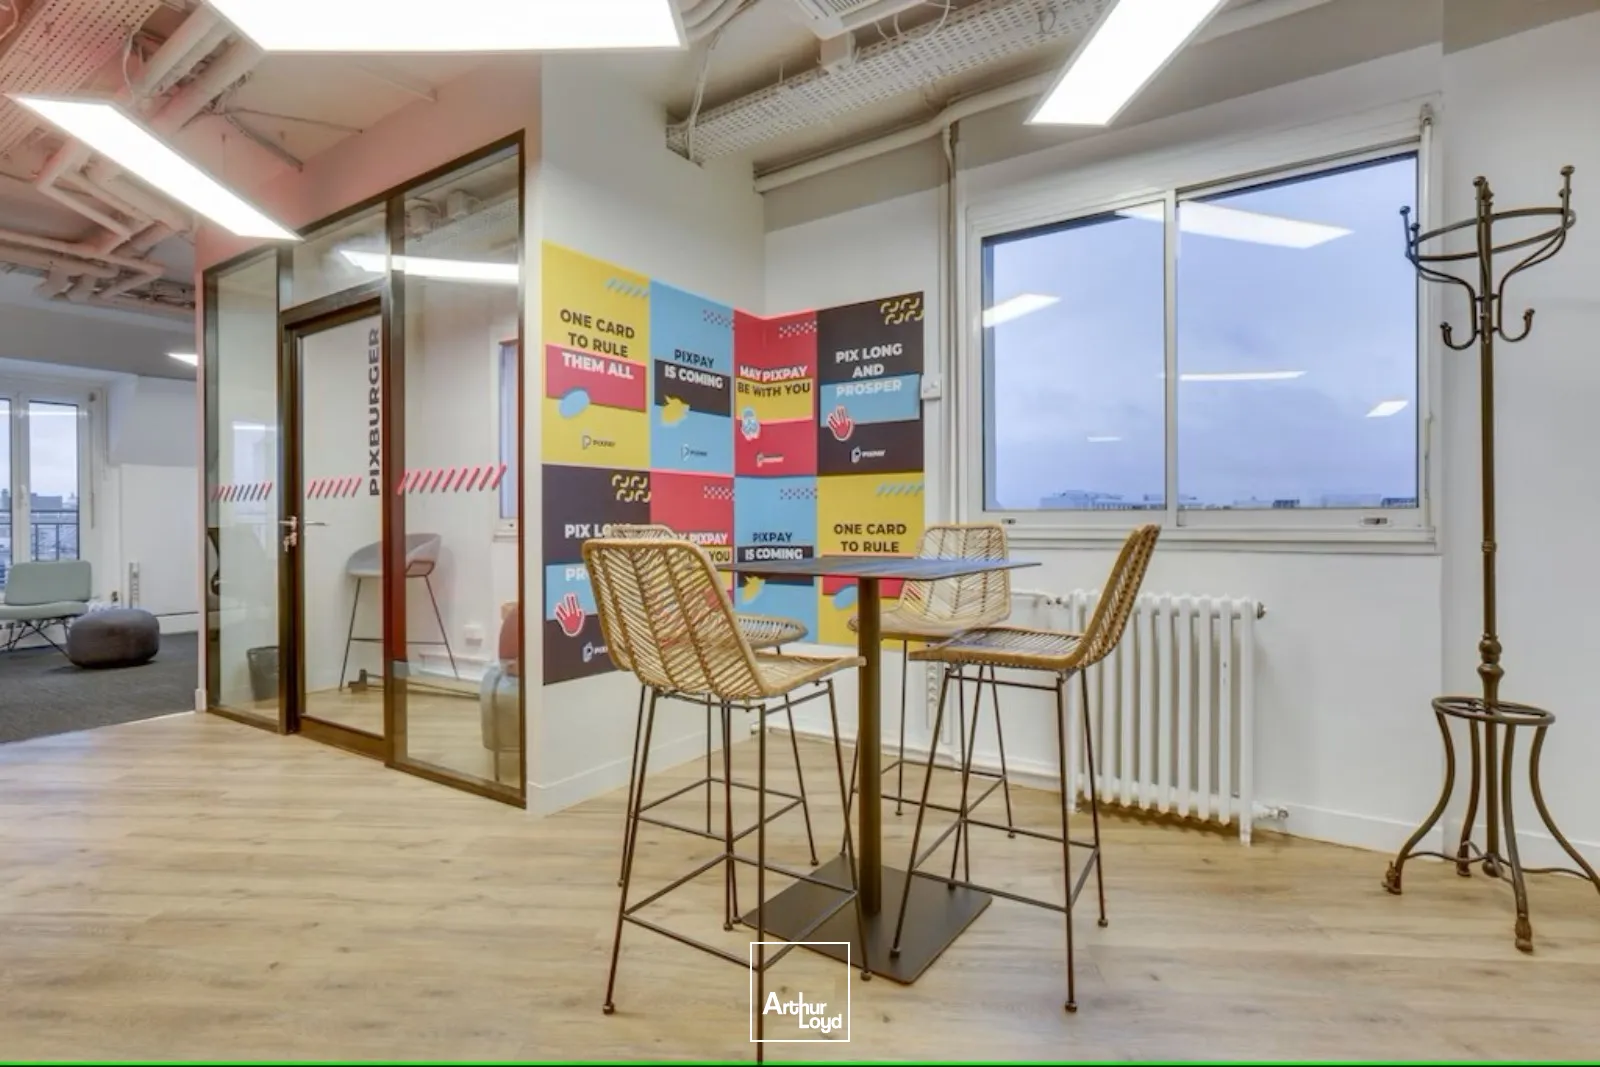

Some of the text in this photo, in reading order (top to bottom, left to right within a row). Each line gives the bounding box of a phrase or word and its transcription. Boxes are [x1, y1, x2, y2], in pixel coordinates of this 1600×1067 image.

[560, 309, 635, 339] ONE CARD
[567, 332, 629, 358] TO RULE
[835, 343, 903, 363] PIX LONG
[562, 352, 634, 380] THEM ALL
[674, 349, 714, 369] PIXPAY
[664, 365, 723, 389] IS COMING
[740, 365, 808, 382] MAY PIXPAY
[852, 363, 885, 379] AND
[737, 382, 811, 397] BE WITH YOU
[836, 380, 902, 397] PROSPER
[369, 327, 380, 496] PIXBURGER
[564, 524, 591, 539] PIX
[833, 523, 907, 535] ONE CARD
[752, 532, 793, 544] PIXPAY
[745, 548, 803, 560] IS COMING
[840, 541, 900, 553] TO RULE
